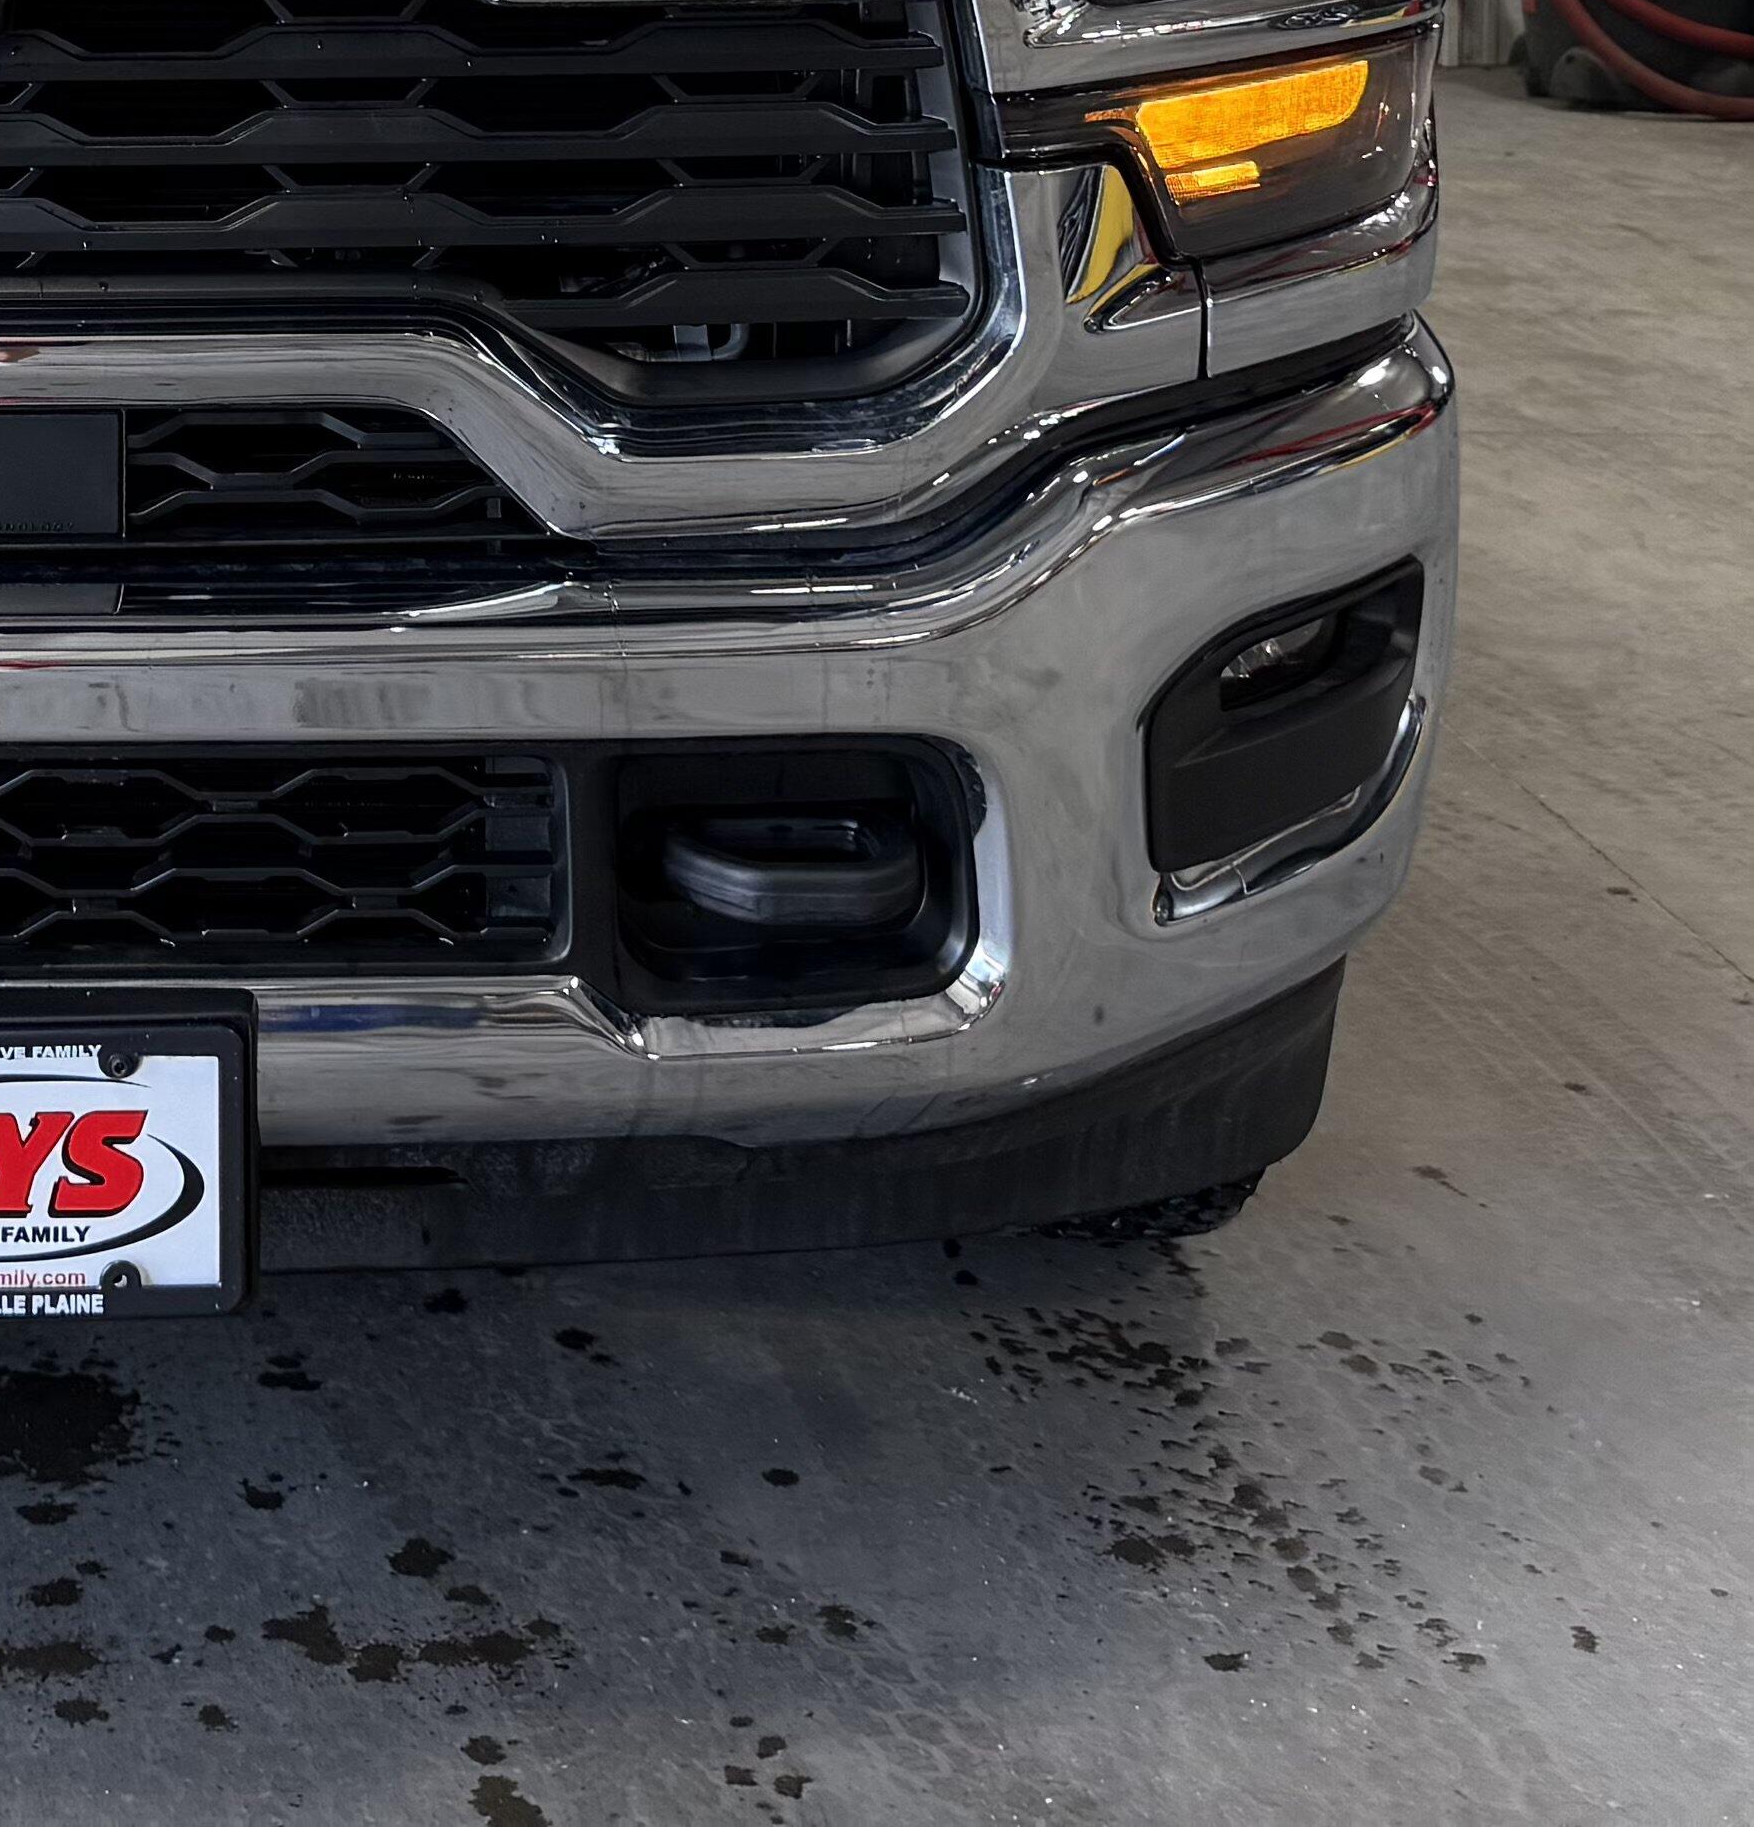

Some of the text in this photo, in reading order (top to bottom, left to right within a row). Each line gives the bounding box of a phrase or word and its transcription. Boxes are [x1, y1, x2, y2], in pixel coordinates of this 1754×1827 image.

[33, 1045, 102, 1059] FAMILY
[1, 1225, 91, 1243] FAMILY
[32, 1294, 104, 1315] PLAINE
